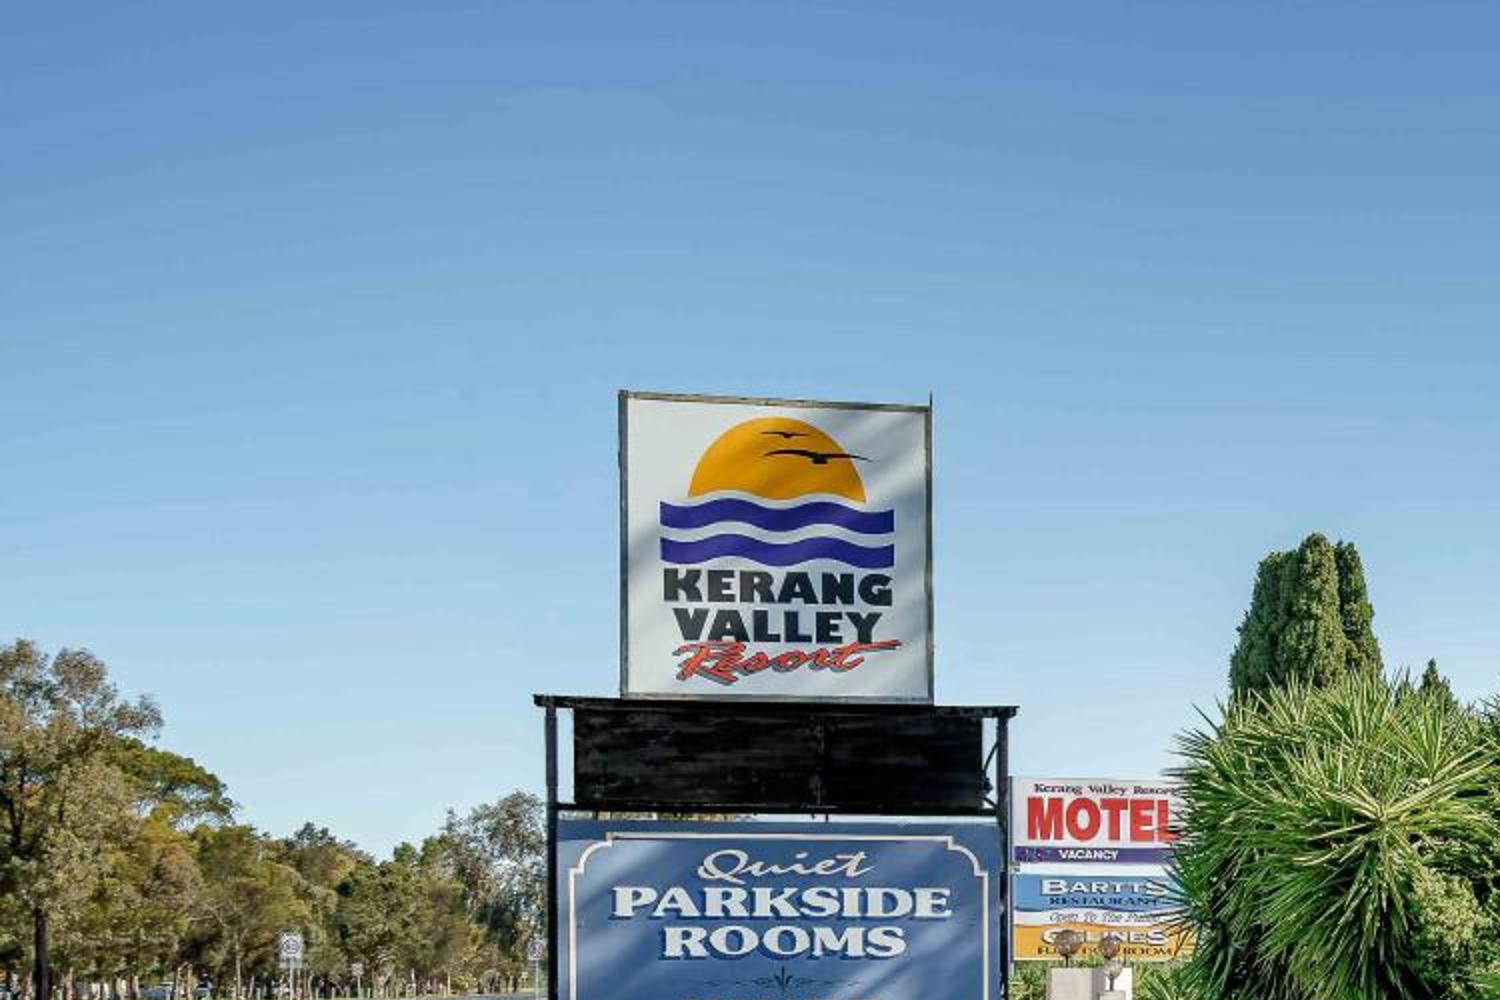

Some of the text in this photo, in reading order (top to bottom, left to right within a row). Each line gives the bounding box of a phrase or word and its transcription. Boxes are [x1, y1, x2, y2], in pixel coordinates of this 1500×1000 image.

[664, 568, 893, 606] KERANG
[672, 608, 882, 643] VALLEY
[672, 640, 901, 686] Resort
[1034, 783, 1082, 795] Kerang
[1089, 784, 1127, 796] Valley
[1027, 797, 1178, 842] MOTEL
[698, 849, 875, 883] Quiet
[1059, 850, 1118, 860] VACANCY
[611, 887, 953, 919] PARKSIDE
[660, 925, 907, 960] ROOMS
